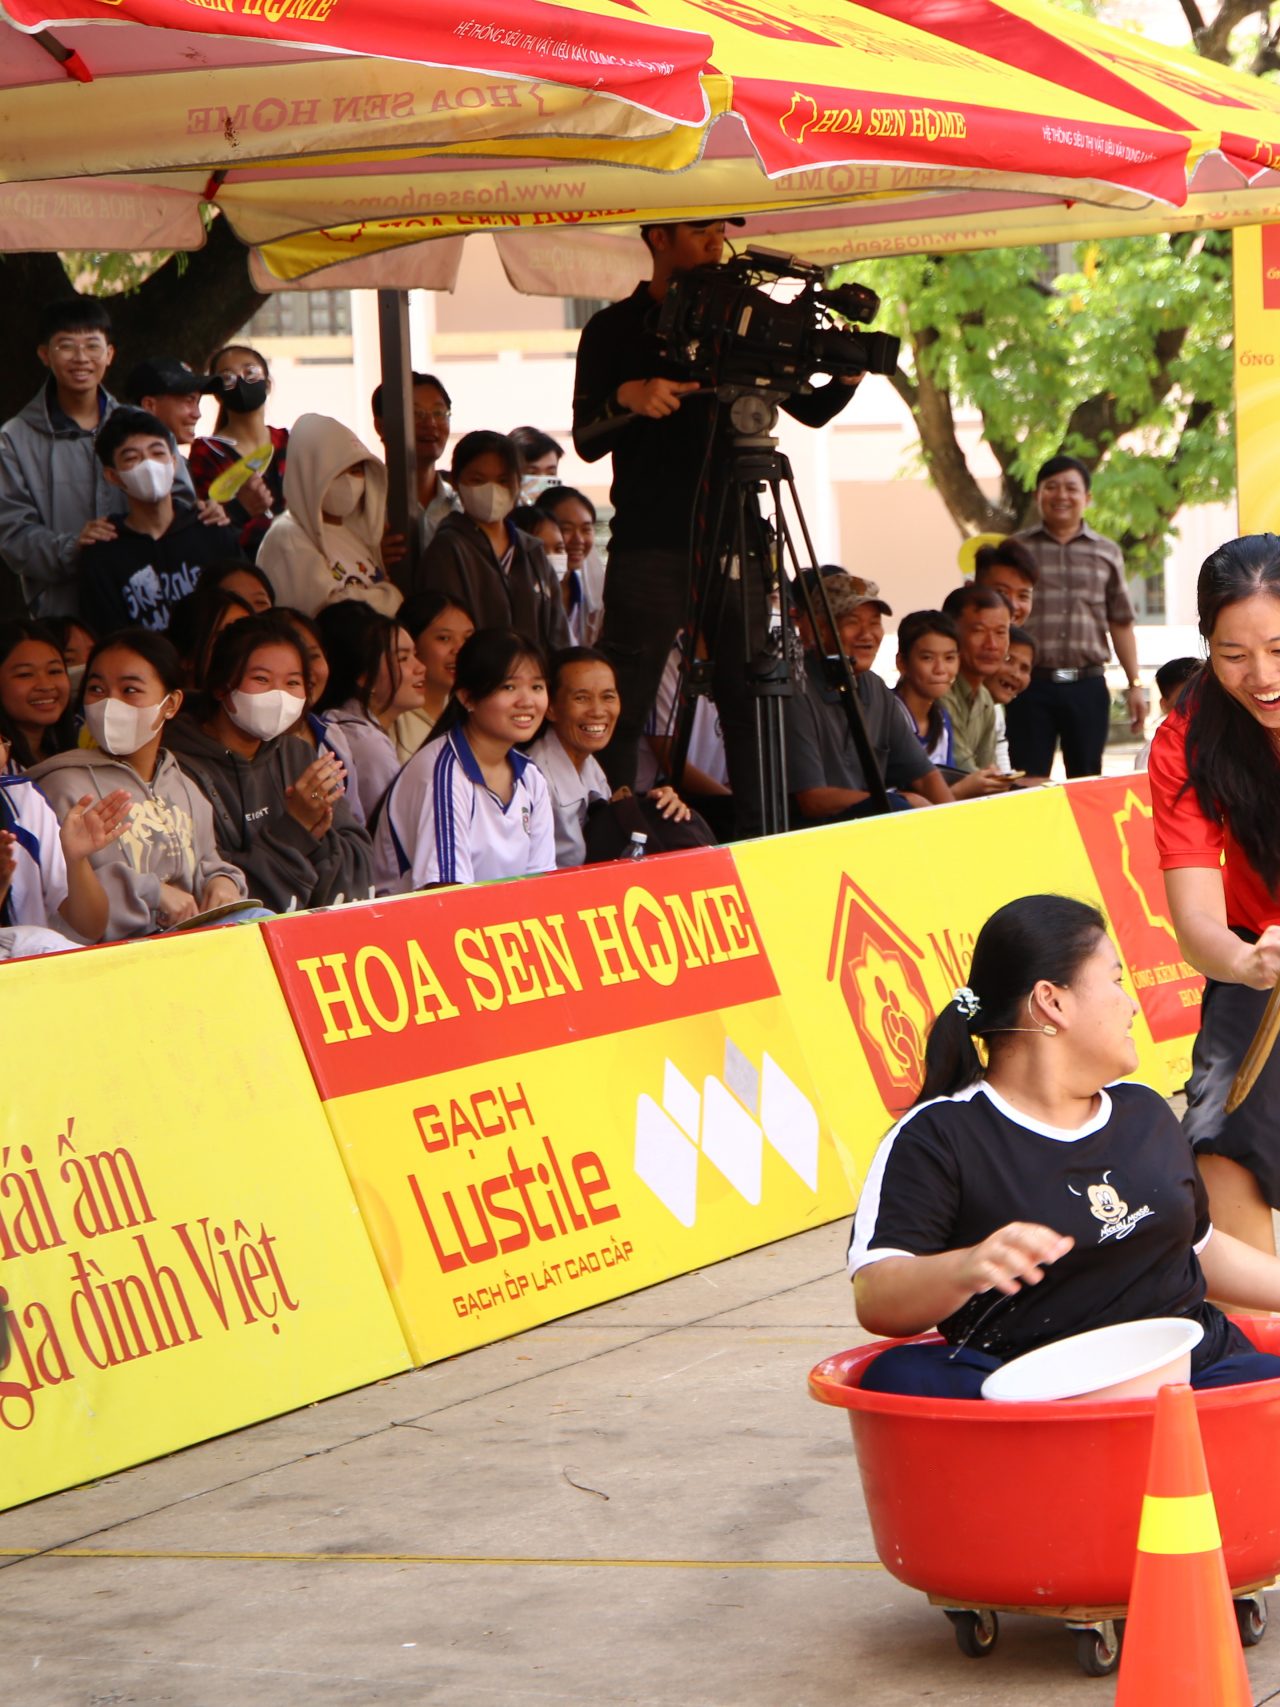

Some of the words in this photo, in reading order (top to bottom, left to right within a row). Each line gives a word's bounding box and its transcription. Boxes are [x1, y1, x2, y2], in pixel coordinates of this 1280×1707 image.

[453, 19, 474, 38] HỆ
[468, 22, 505, 42] THỐNG
[501, 29, 523, 46] SIÊU
[520, 34, 537, 54] THỊ
[536, 37, 554, 57] VẬT
[811, 108, 862, 134] HOA
[865, 108, 906, 137] SEN
[910, 107, 967, 142] HOME
[1239, 351, 1275, 366] ỐNG
[296, 940, 460, 1045] HOA
[454, 914, 584, 1012] SEN
[577, 884, 760, 987] HOME
[412, 1082, 535, 1160] GẠCH
[0, 1146, 67, 1261] ái
[59, 1117, 157, 1239] ấm
[407, 1135, 621, 1274] Lustile
[68, 1234, 203, 1371] đình
[172, 1217, 301, 1336] Việt
[452, 1283, 506, 1320] GẠCH
[530, 1259, 566, 1292] LÁT
[564, 1251, 600, 1281] CAO
[600, 1235, 634, 1268] CẤP
